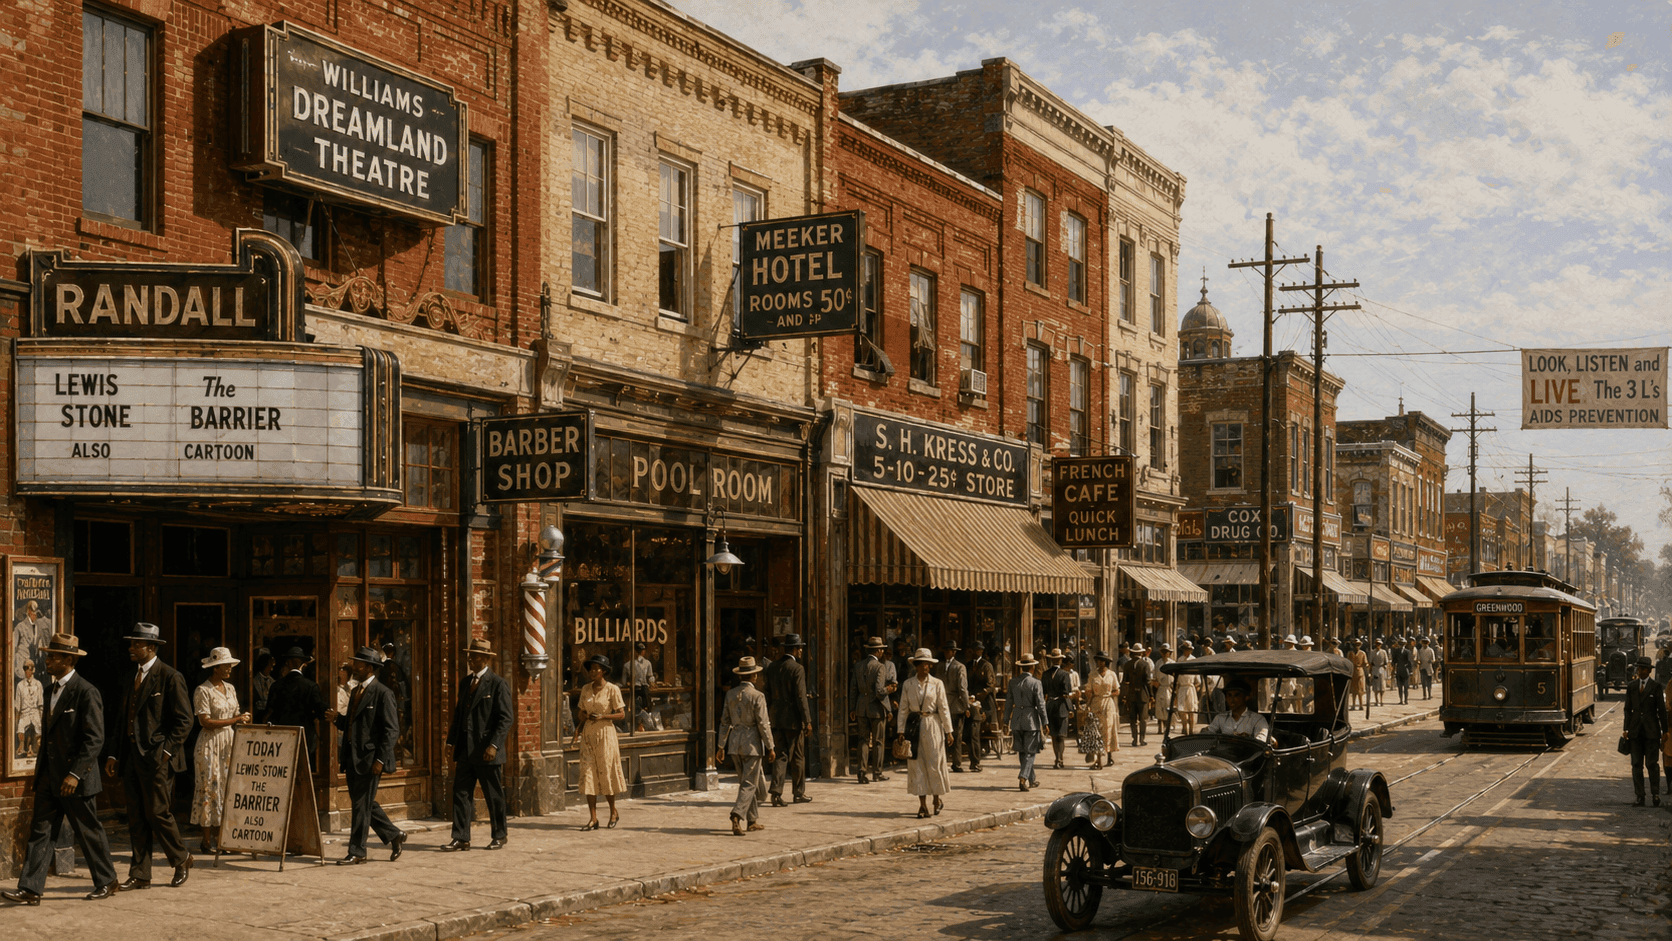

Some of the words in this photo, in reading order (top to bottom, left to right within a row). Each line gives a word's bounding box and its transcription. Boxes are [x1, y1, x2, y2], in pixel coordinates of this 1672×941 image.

[322, 59, 424, 118] WILLIAMS
[293, 85, 447, 166] DREAMLAND
[314, 136, 429, 199] THEATRE
[755, 223, 844, 252] MEEKER
[752, 251, 842, 286] HOTEL
[56, 283, 256, 327] RANDALL
[750, 290, 813, 312] ROOMS
[776, 314, 803, 328] AND
[1529, 355, 1571, 375] LOOK,
[1576, 355, 1629, 372] LISTEN
[1634, 354, 1660, 372] and
[55, 373, 119, 397] LEWIS
[202, 376, 236, 398] The
[1530, 379, 1581, 404] LIVE
[1594, 379, 1621, 399] The
[1626, 380, 1637, 399] 3
[1641, 379, 1660, 399] L's
[61, 404, 132, 428] STONE
[190, 406, 282, 431] BARRIER
[1529, 409, 1563, 424] AIDS
[1569, 409, 1659, 423] PREVENTION
[71, 442, 110, 459] ALSO
[184, 444, 254, 460] CARTOON
[489, 426, 580, 458] BARBER
[875, 423, 892, 450] S.
[900, 428, 917, 455] H.
[924, 433, 977, 466] KRESS
[981, 448, 991, 468] &
[993, 448, 1015, 473] CO.
[497, 461, 571, 491] SHOP
[633, 455, 701, 495] POOL
[712, 467, 773, 504] ROOM
[1059, 463, 1125, 480] FRENCH
[966, 472, 1014, 498] STORE
[1064, 483, 1119, 502] CAFE
[1068, 510, 1116, 525] QUICK
[1228, 509, 1261, 523] COX
[1065, 527, 1119, 542] LUNCH
[1211, 525, 1250, 539] DRUG
[574, 617, 668, 645] BILLIARDS
[1537, 682, 1546, 694] 5
[246, 740, 282, 757] TODAY
[235, 763, 259, 776] LEWIS
[262, 765, 288, 778] STONE
[251, 781, 267, 792] THE
[233, 793, 280, 812] BARRIER
[244, 816, 264, 826] ALSO
[232, 828, 273, 842] CARTOON
[1136, 870, 1176, 888] 156-918
